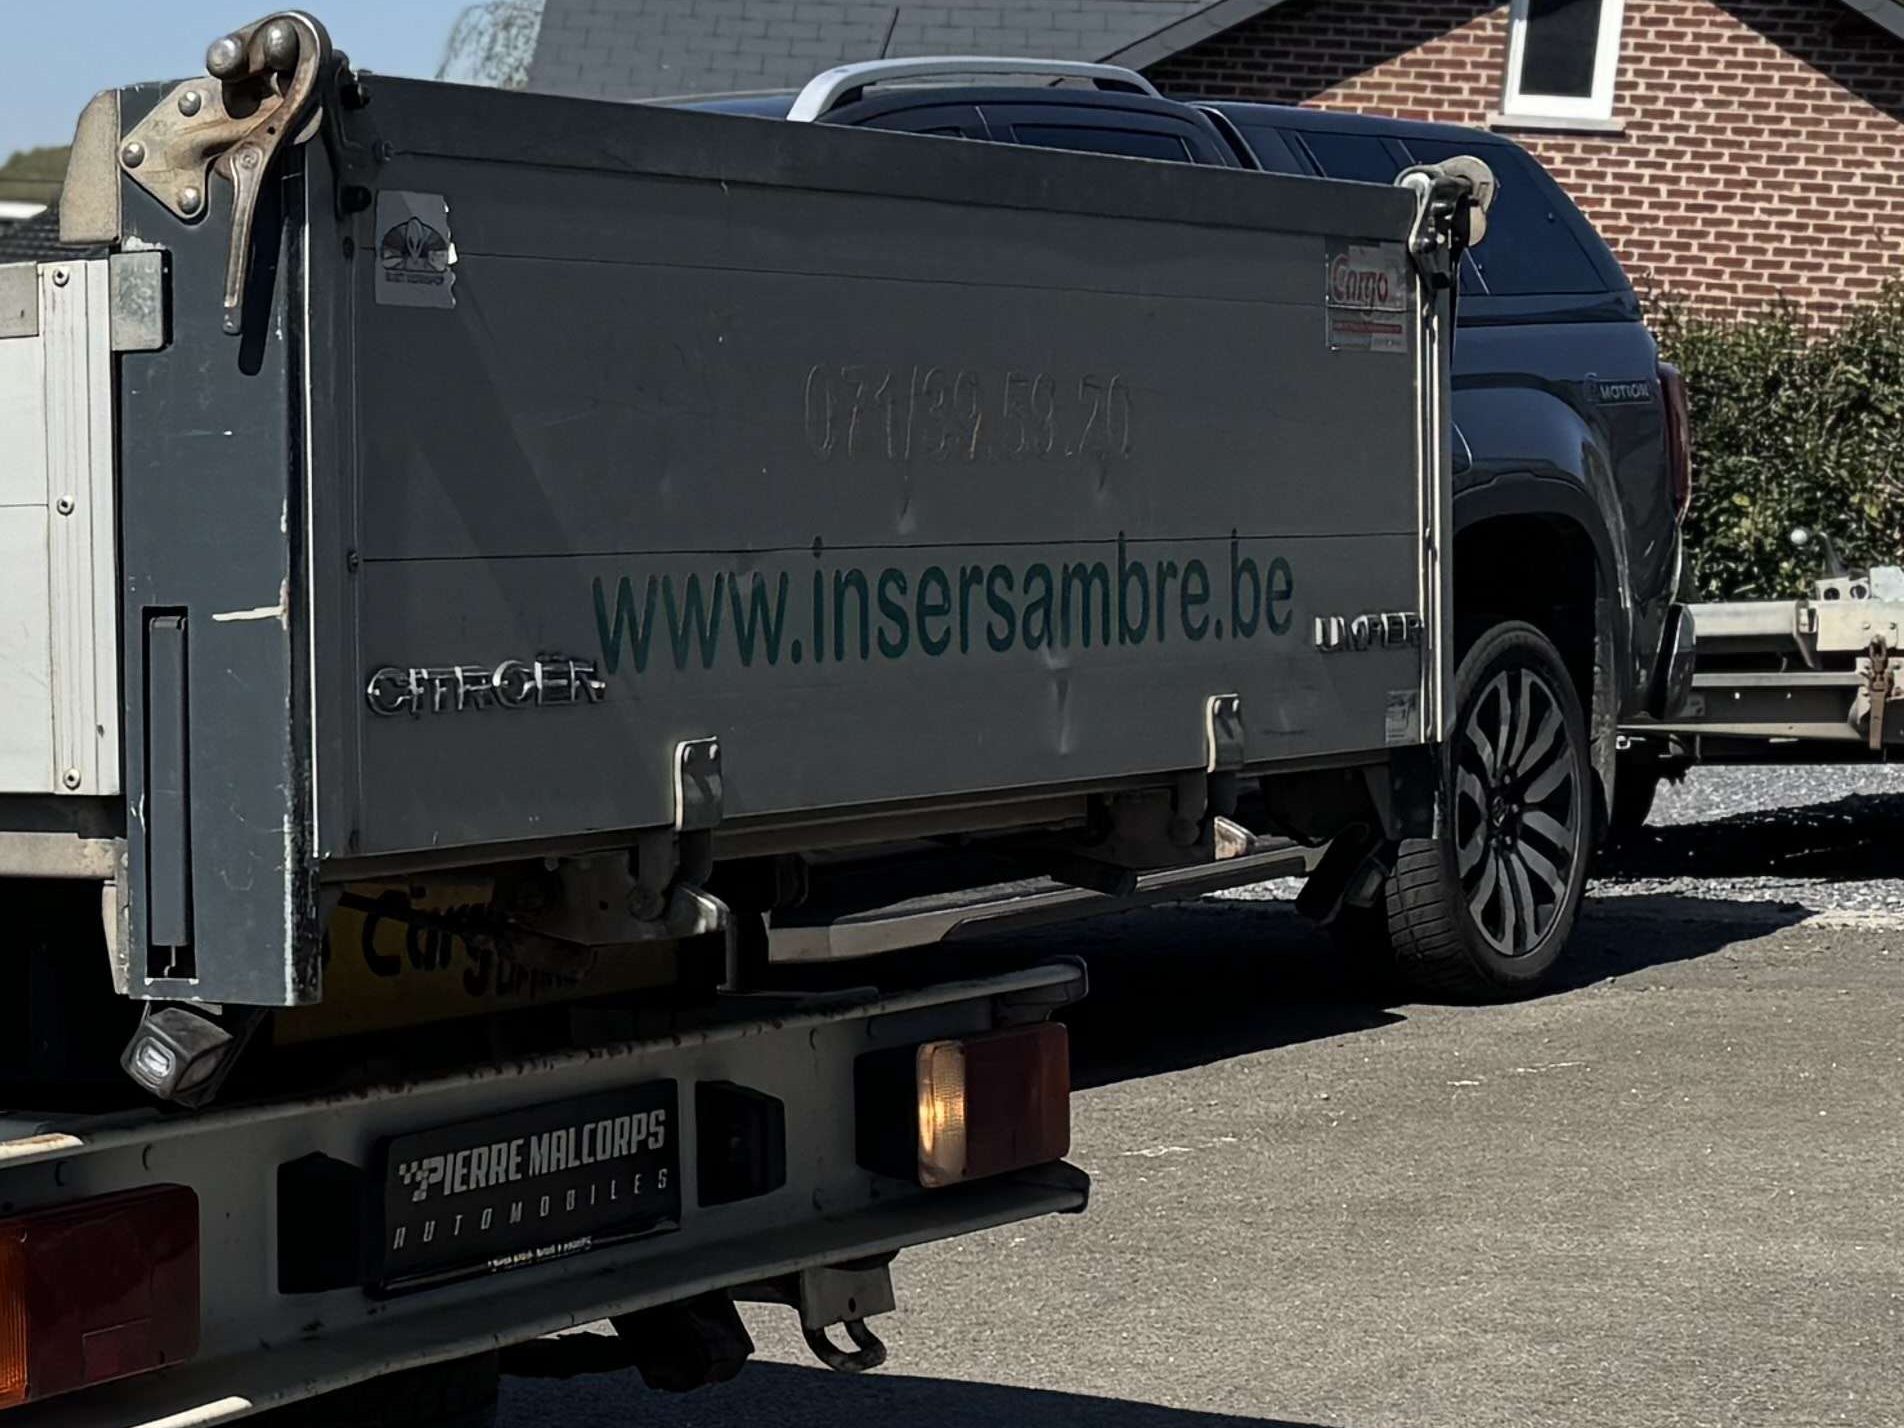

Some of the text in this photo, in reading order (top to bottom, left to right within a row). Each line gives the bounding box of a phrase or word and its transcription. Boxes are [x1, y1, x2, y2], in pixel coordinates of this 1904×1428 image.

[592, 530, 1294, 675] www.insersambre.be
[410, 1108, 668, 1203] PIERRE MALCORPS
[392, 1167, 671, 1251] AUTOMOBILES
